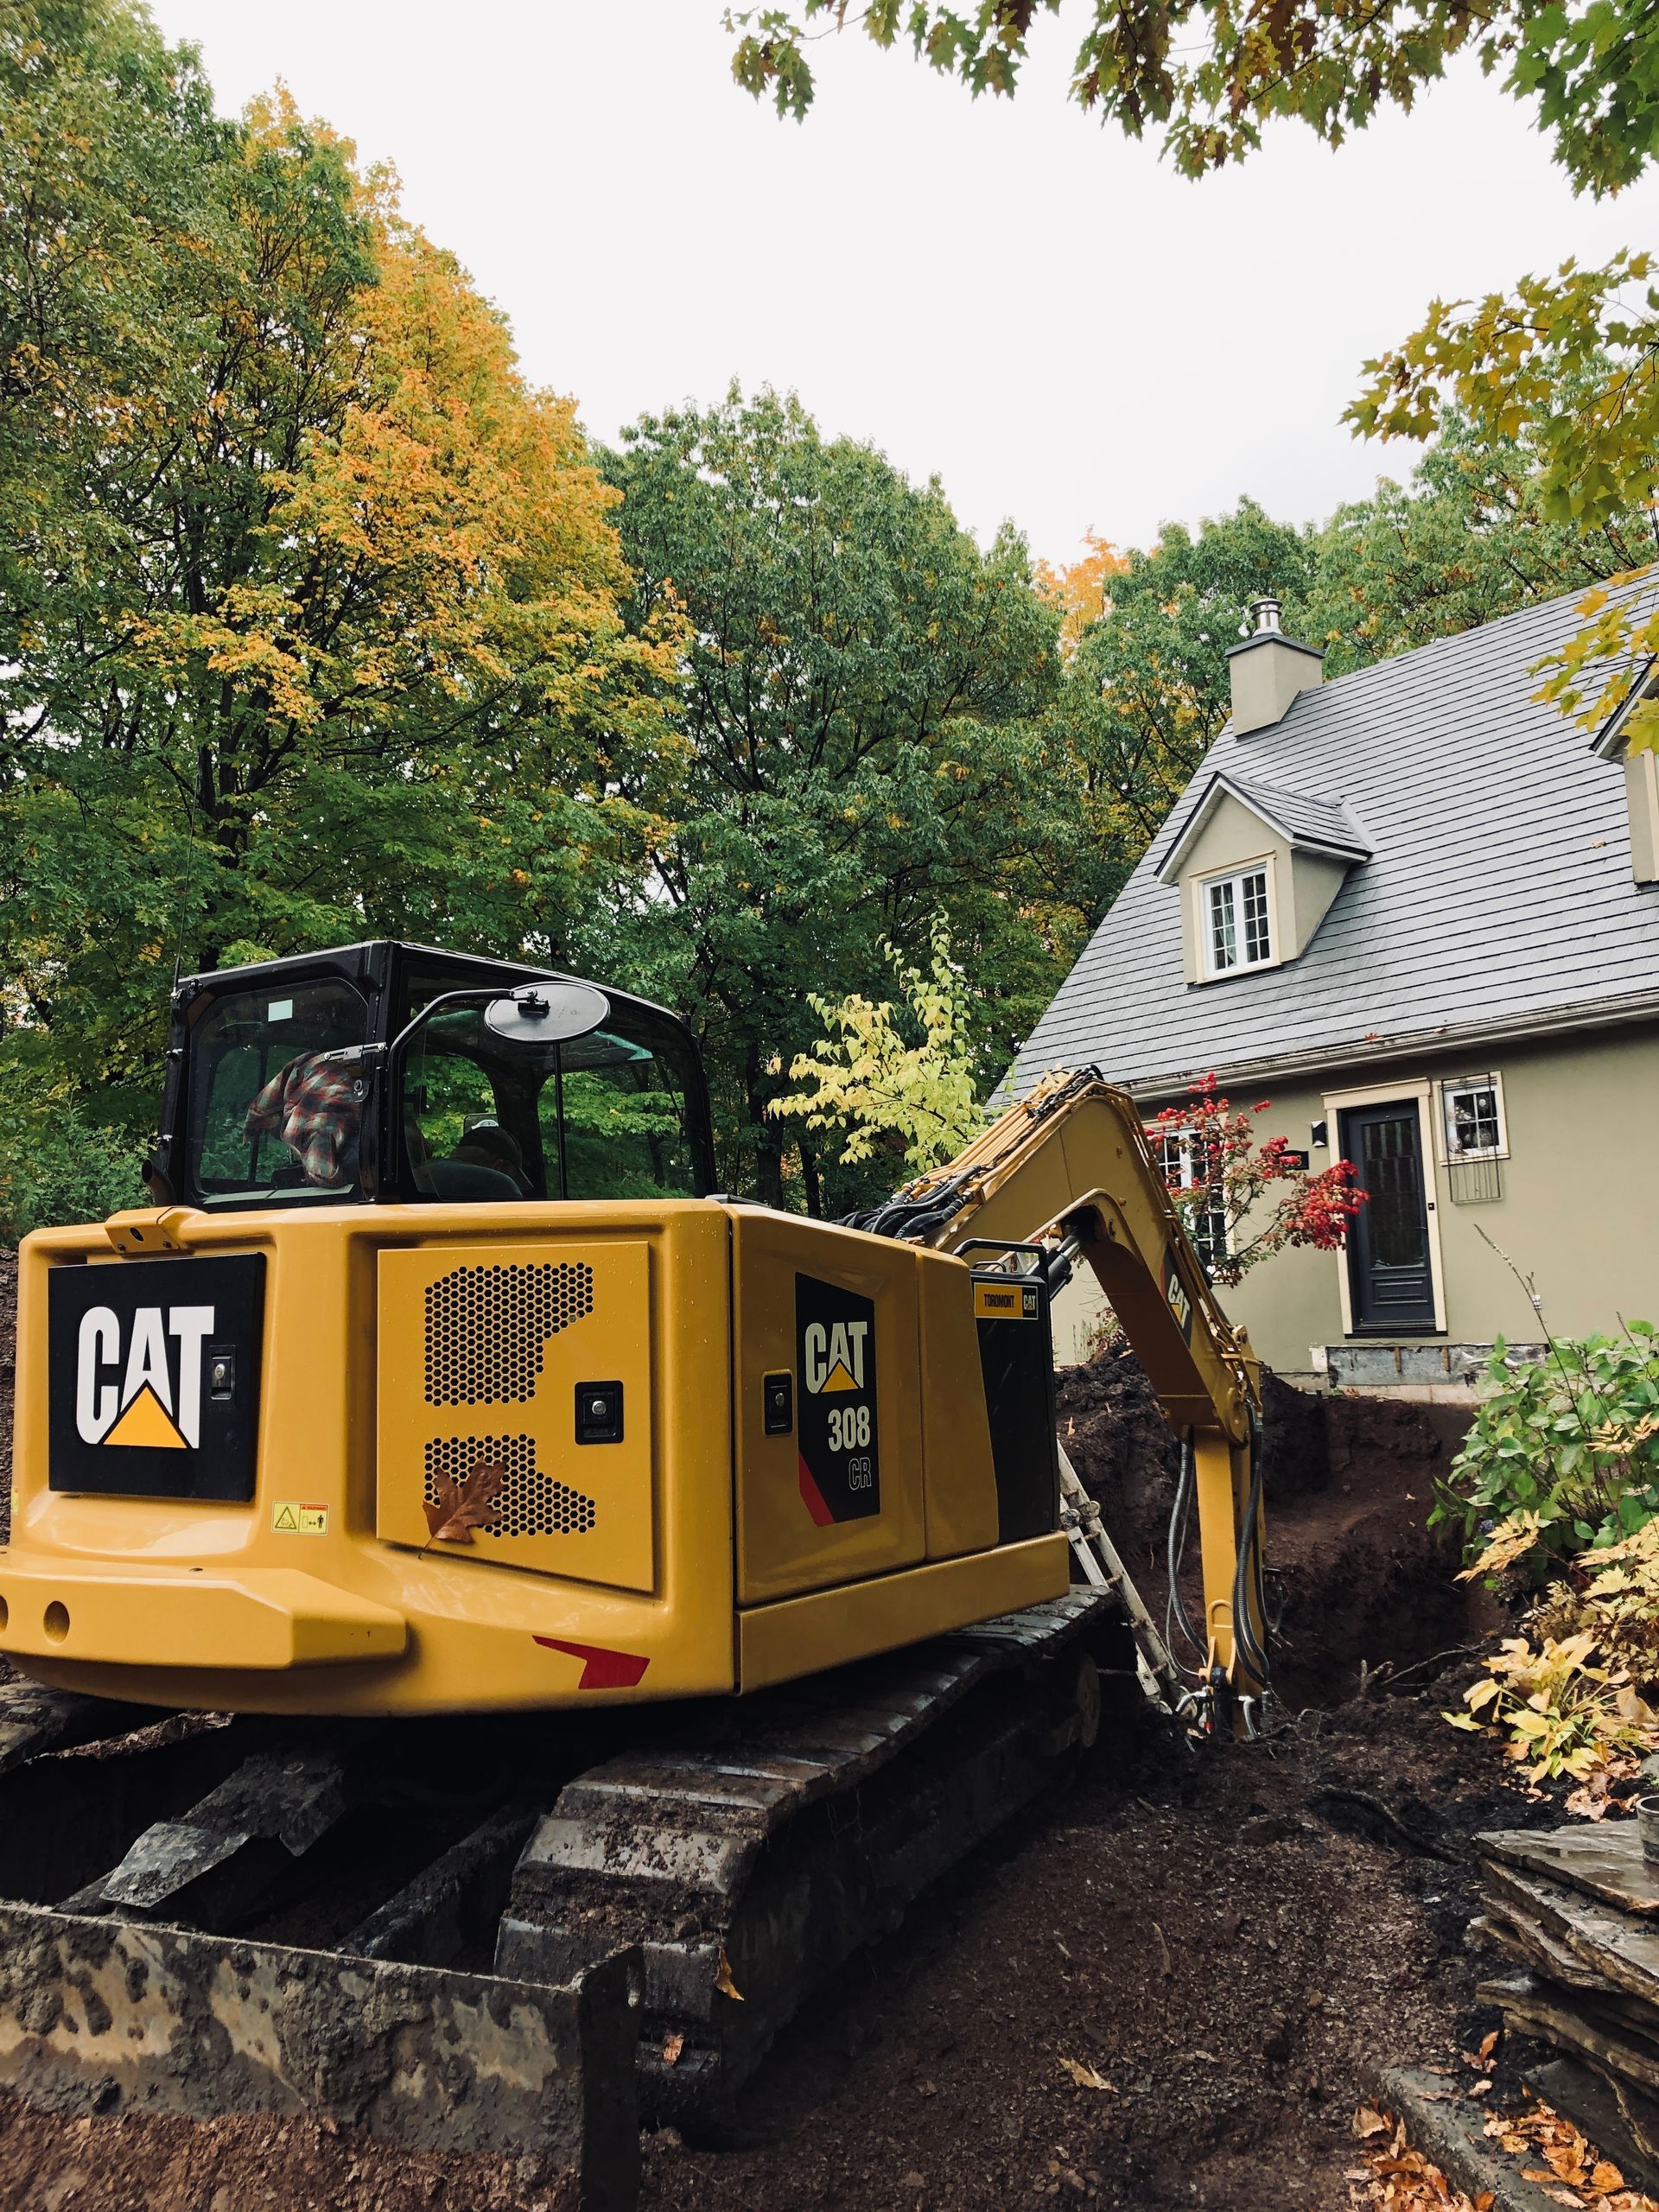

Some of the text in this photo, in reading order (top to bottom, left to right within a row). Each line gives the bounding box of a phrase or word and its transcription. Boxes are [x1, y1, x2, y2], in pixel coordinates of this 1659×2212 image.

[983, 1294, 1014, 1308] TOROMONT
[1023, 1294, 1036, 1311] CAT
[1167, 1274, 1191, 1329] CAT
[76, 1306, 214, 1449] CAT
[804, 1321, 868, 1394] CAT
[828, 1406, 870, 1452] 308
[849, 1458, 872, 1491] CR
